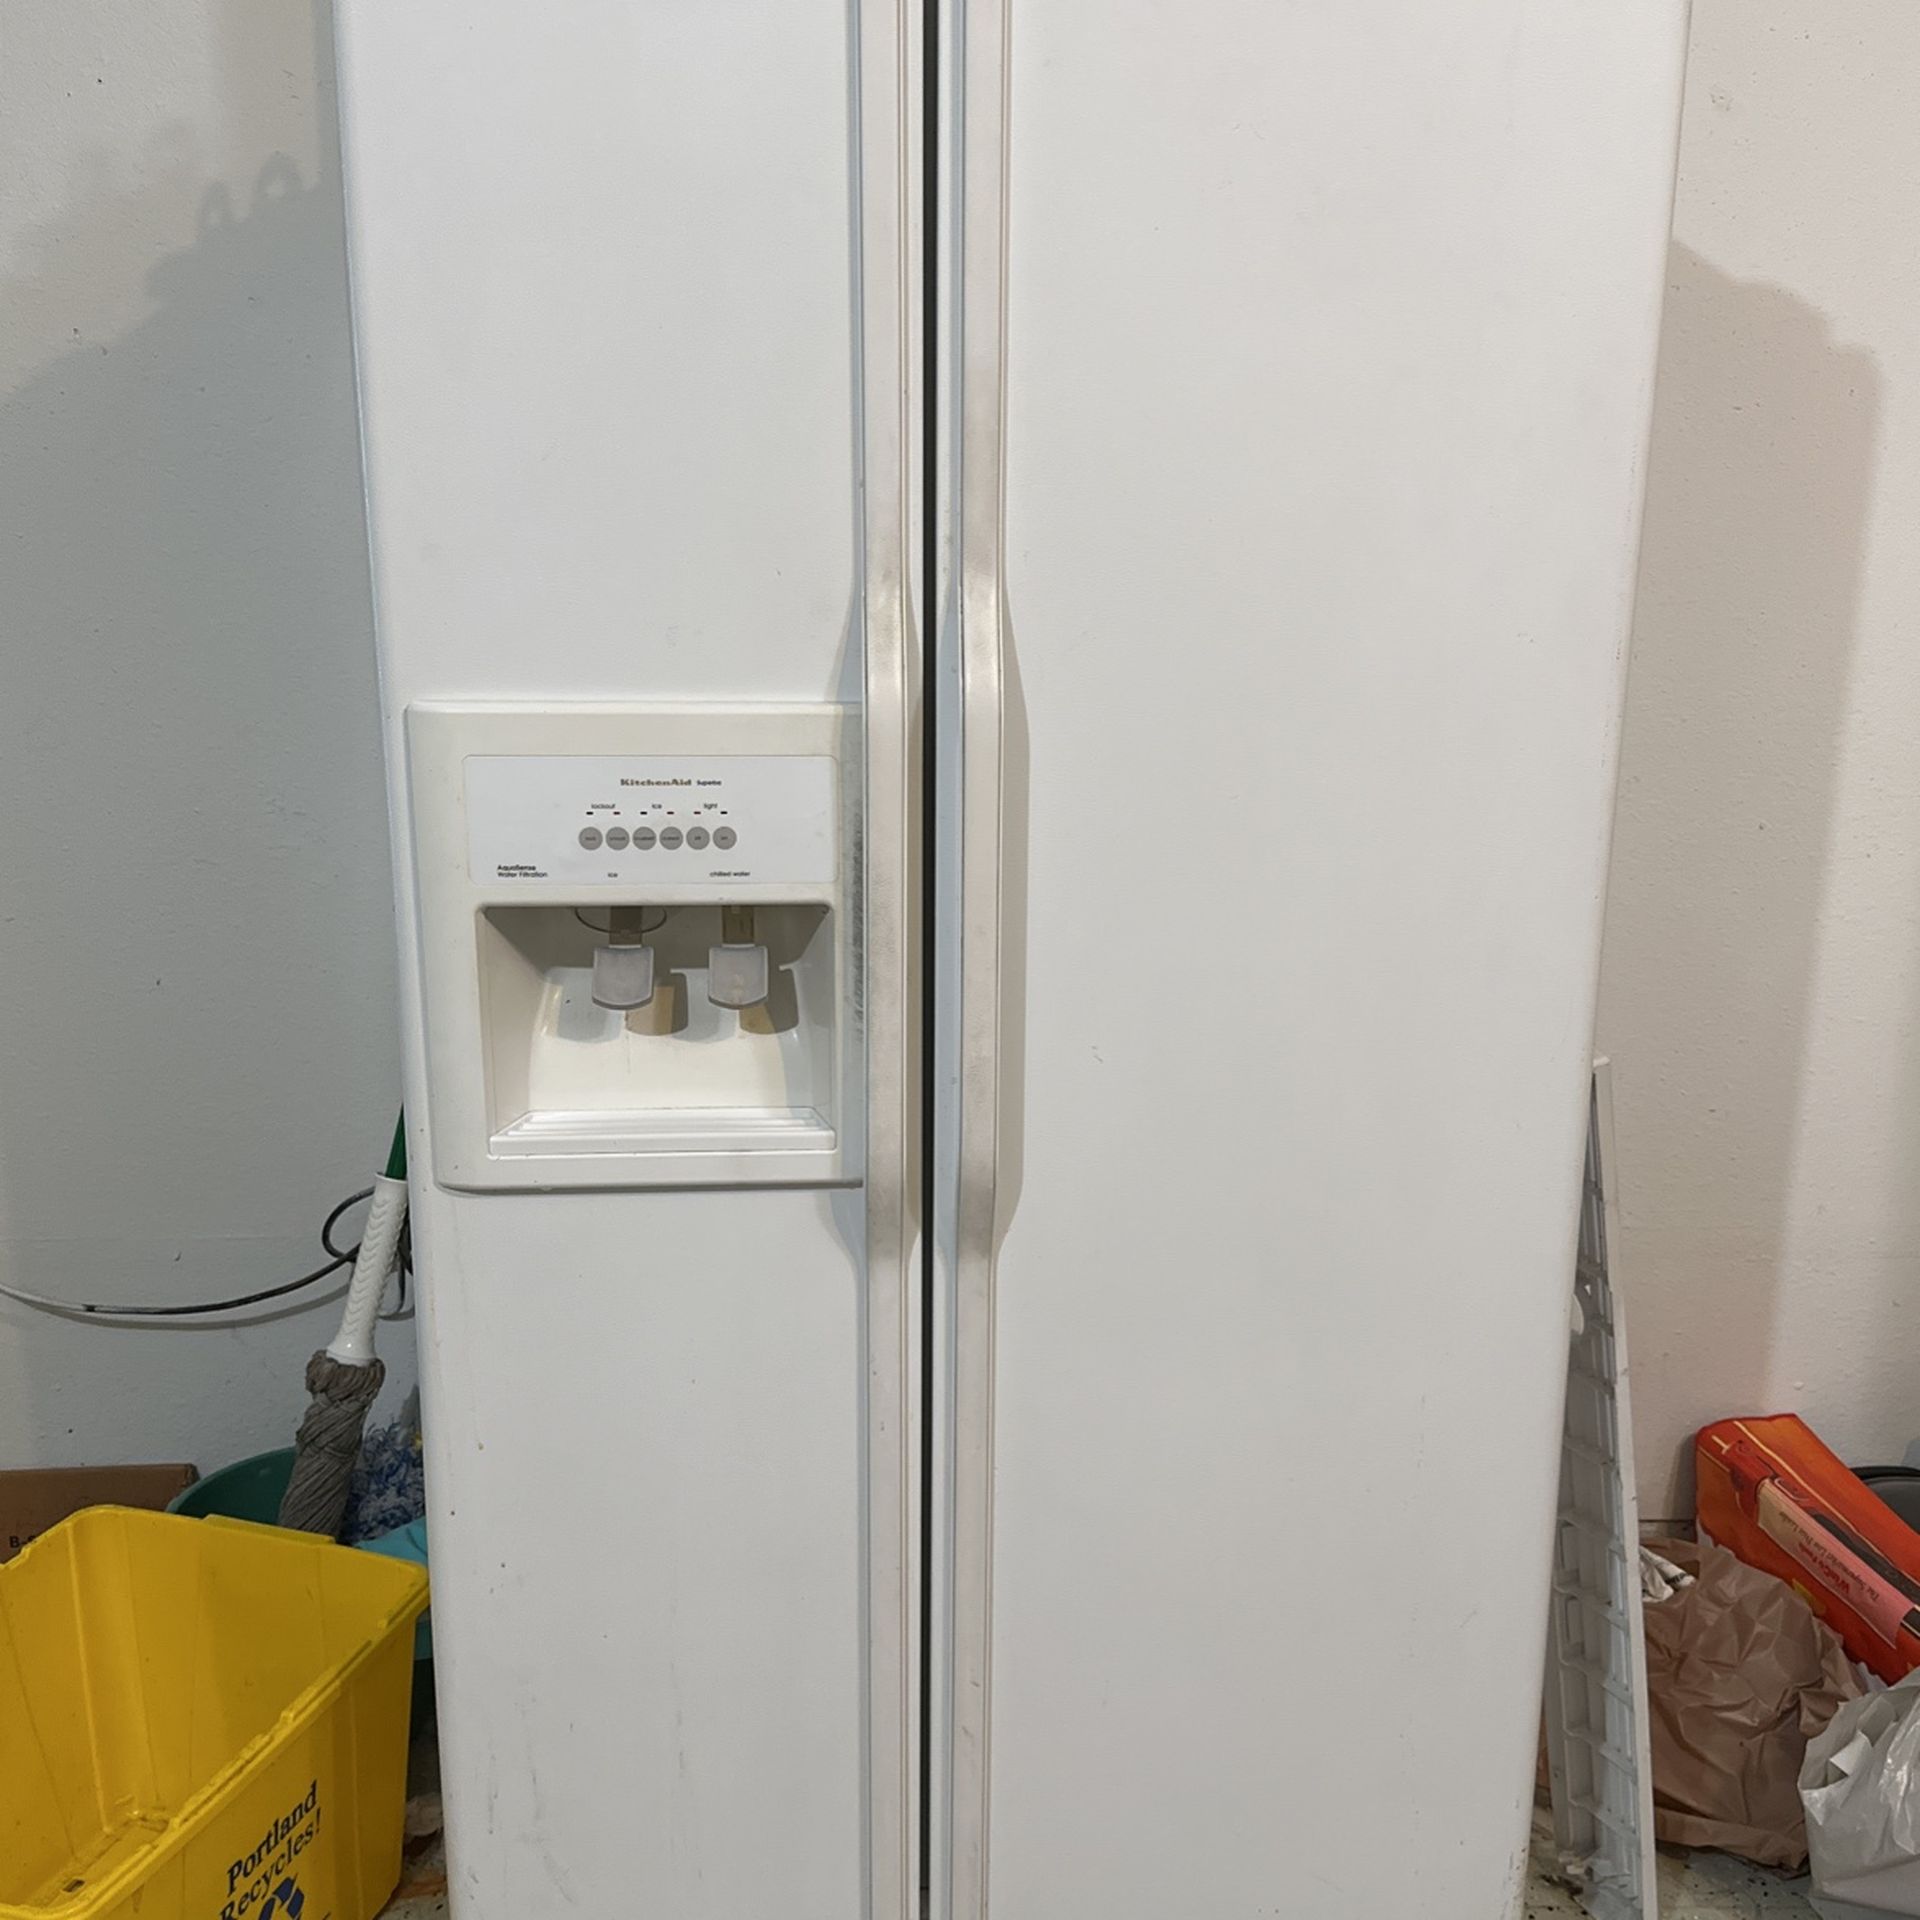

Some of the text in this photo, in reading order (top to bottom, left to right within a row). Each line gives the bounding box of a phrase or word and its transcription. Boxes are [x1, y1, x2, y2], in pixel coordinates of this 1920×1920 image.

[620, 778, 692, 787] KitchenAid
[220, 1807, 321, 1920] Recycles!
[227, 1779, 317, 1897] Portland
